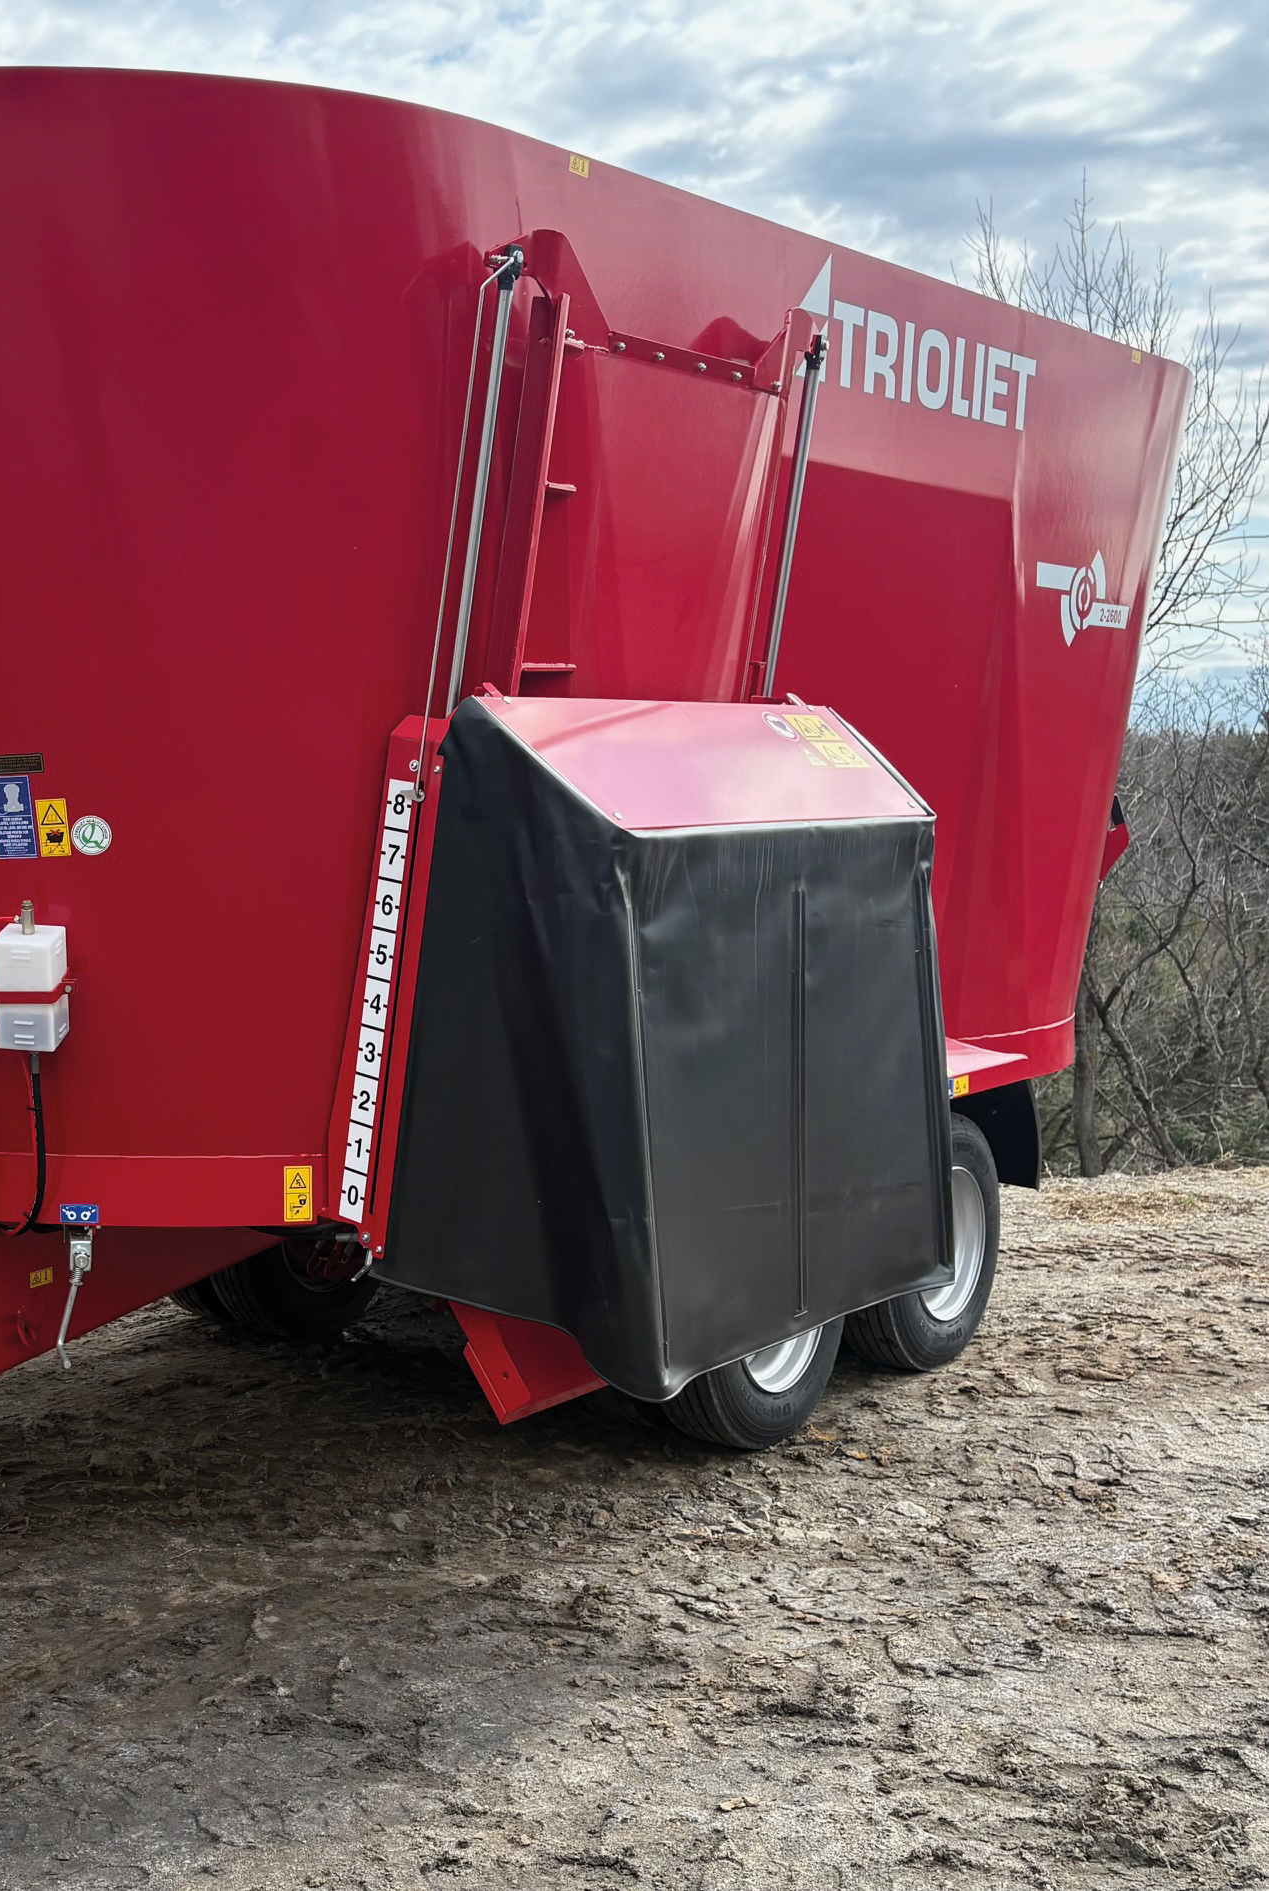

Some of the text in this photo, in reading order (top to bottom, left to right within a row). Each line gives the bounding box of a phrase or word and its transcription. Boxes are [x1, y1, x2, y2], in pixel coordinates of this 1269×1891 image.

[833, 299, 1037, 432] TRIOLIET
[1100, 608, 1122, 624] 2-2600
[392, 793, 406, 815] 8
[388, 844, 401, 865] 7
[381, 894, 393, 916] 6
[375, 943, 388, 965] 5
[370, 994, 382, 1015] 4
[364, 1042, 376, 1063] 3
[358, 1090, 370, 1112] 2
[354, 1138, 362, 1158] 1
[347, 1185, 359, 1206] 0
